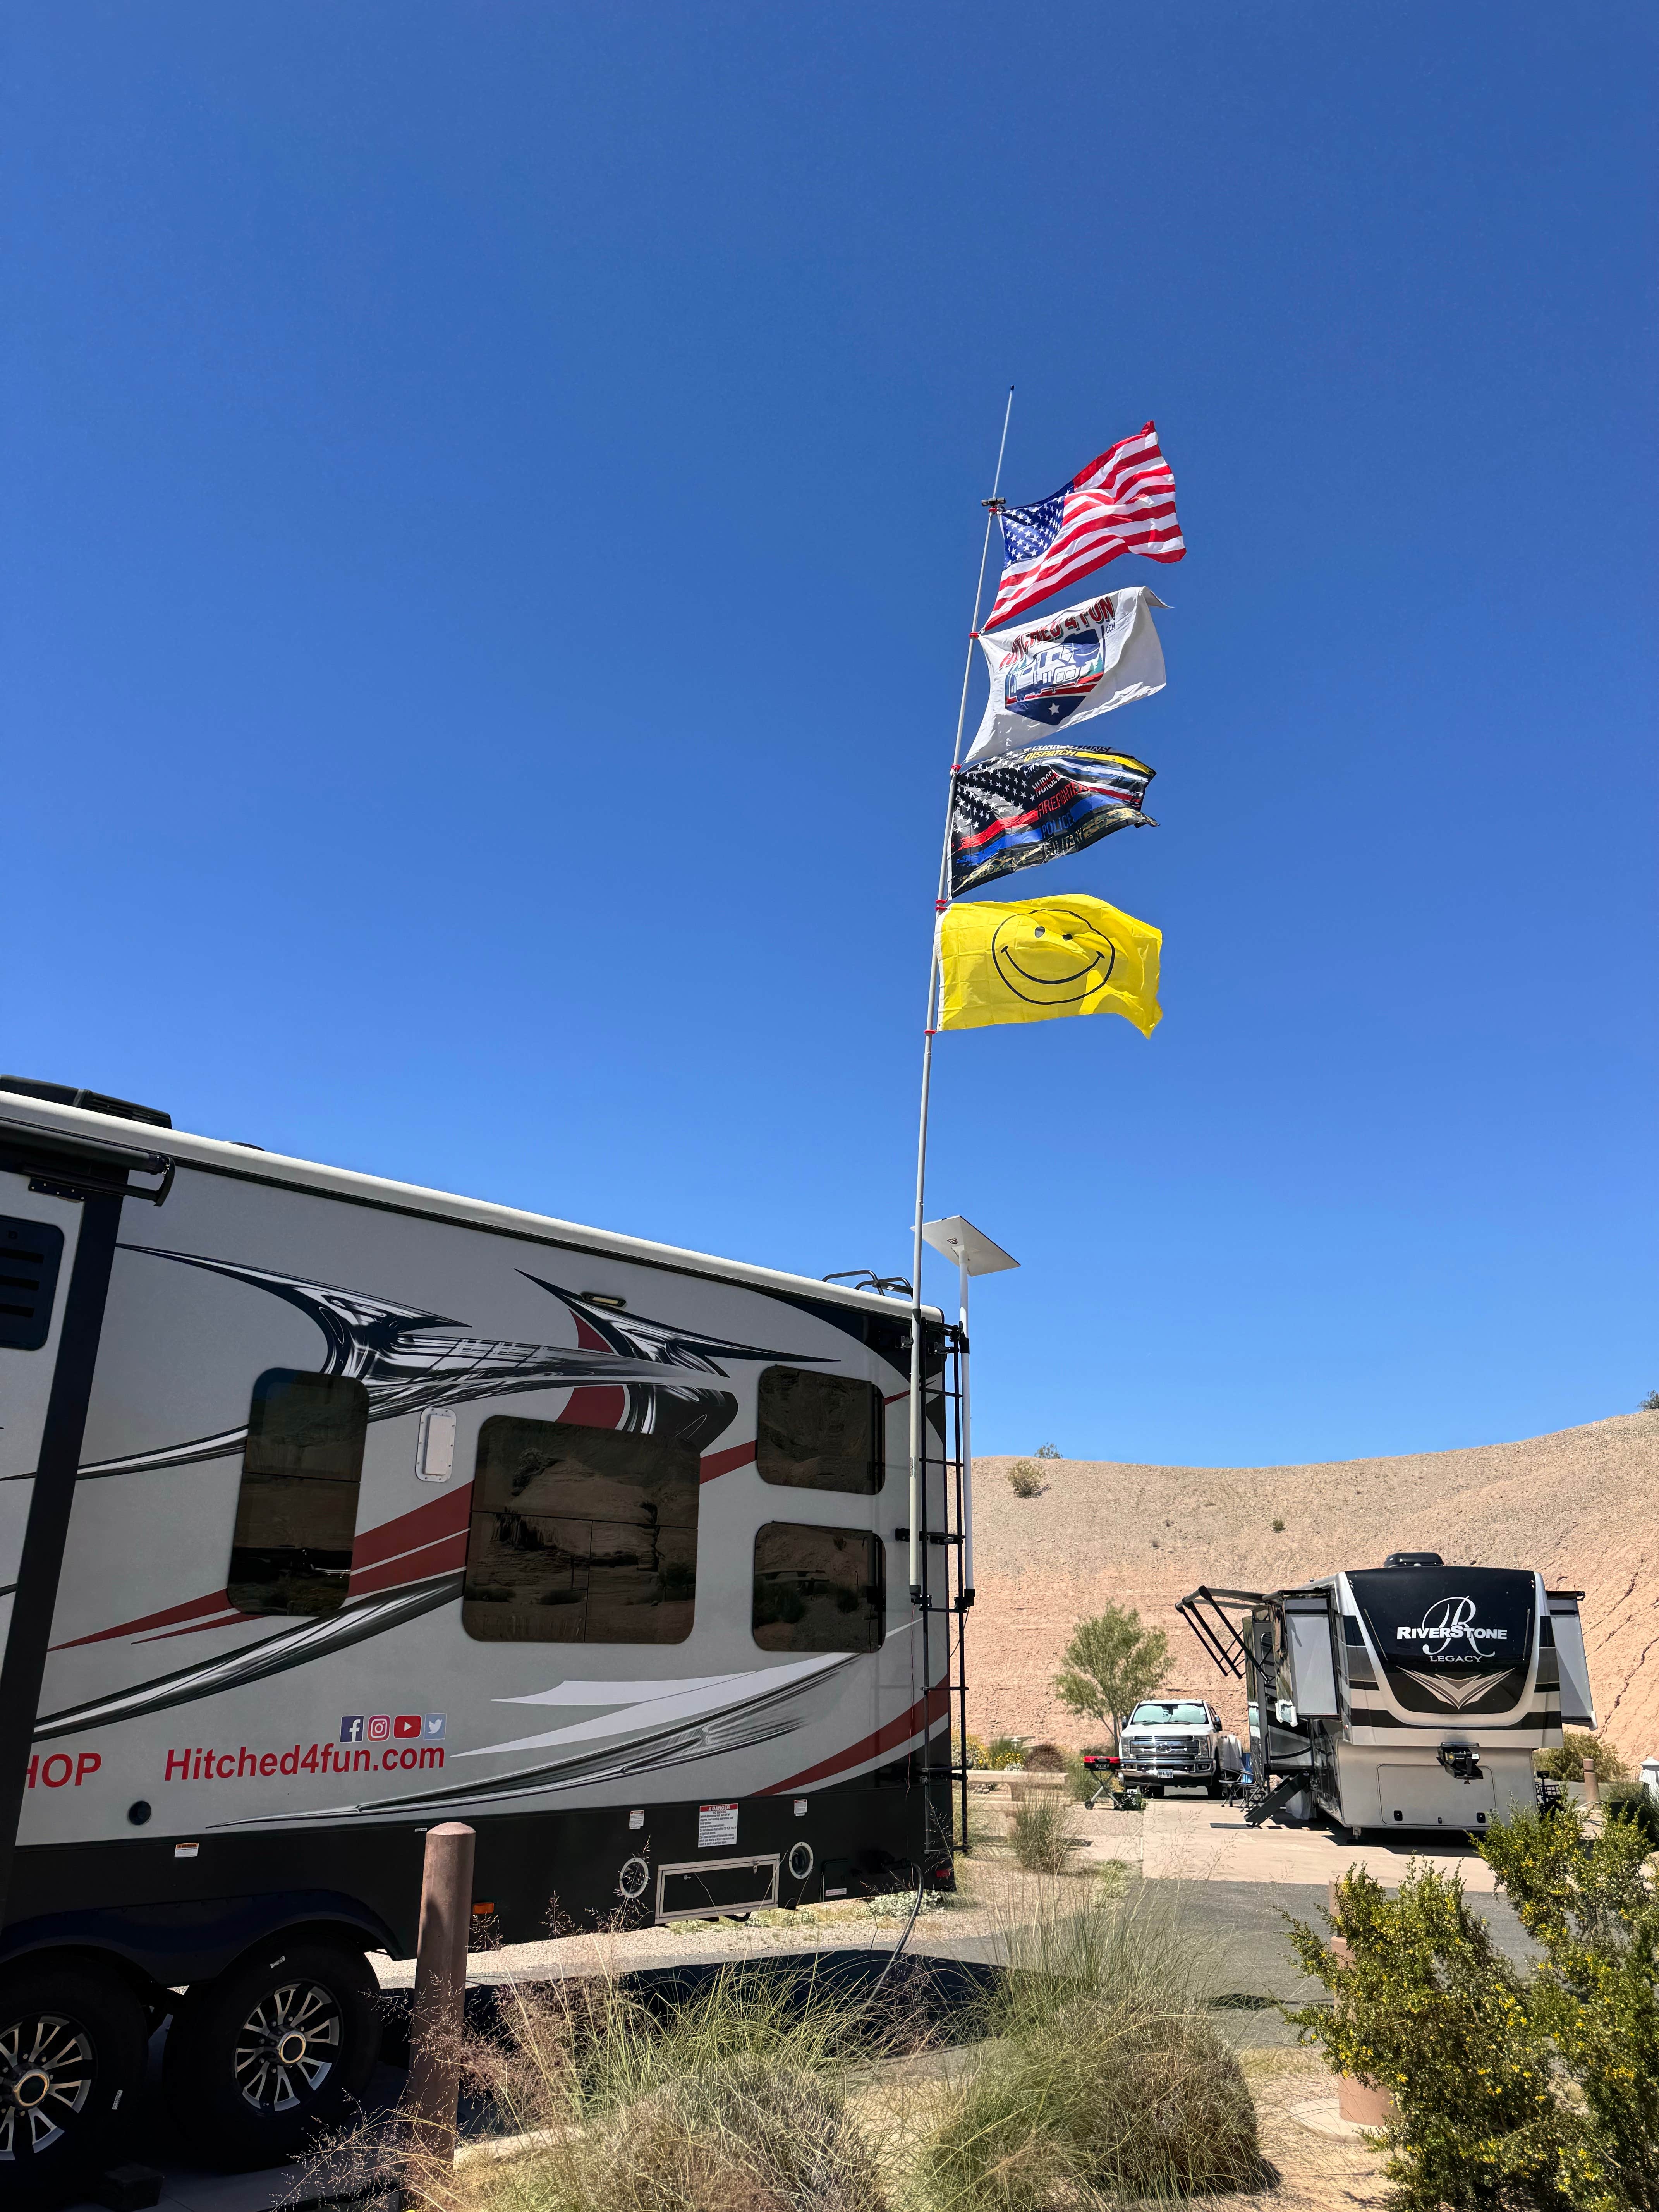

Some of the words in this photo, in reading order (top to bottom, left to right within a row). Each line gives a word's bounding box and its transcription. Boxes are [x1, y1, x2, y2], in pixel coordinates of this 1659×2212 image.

[1024, 749, 1076, 762] DISPATCH
[1042, 812, 1073, 839] POLICE
[165, 1743, 445, 1781] Hitched4fun.com
